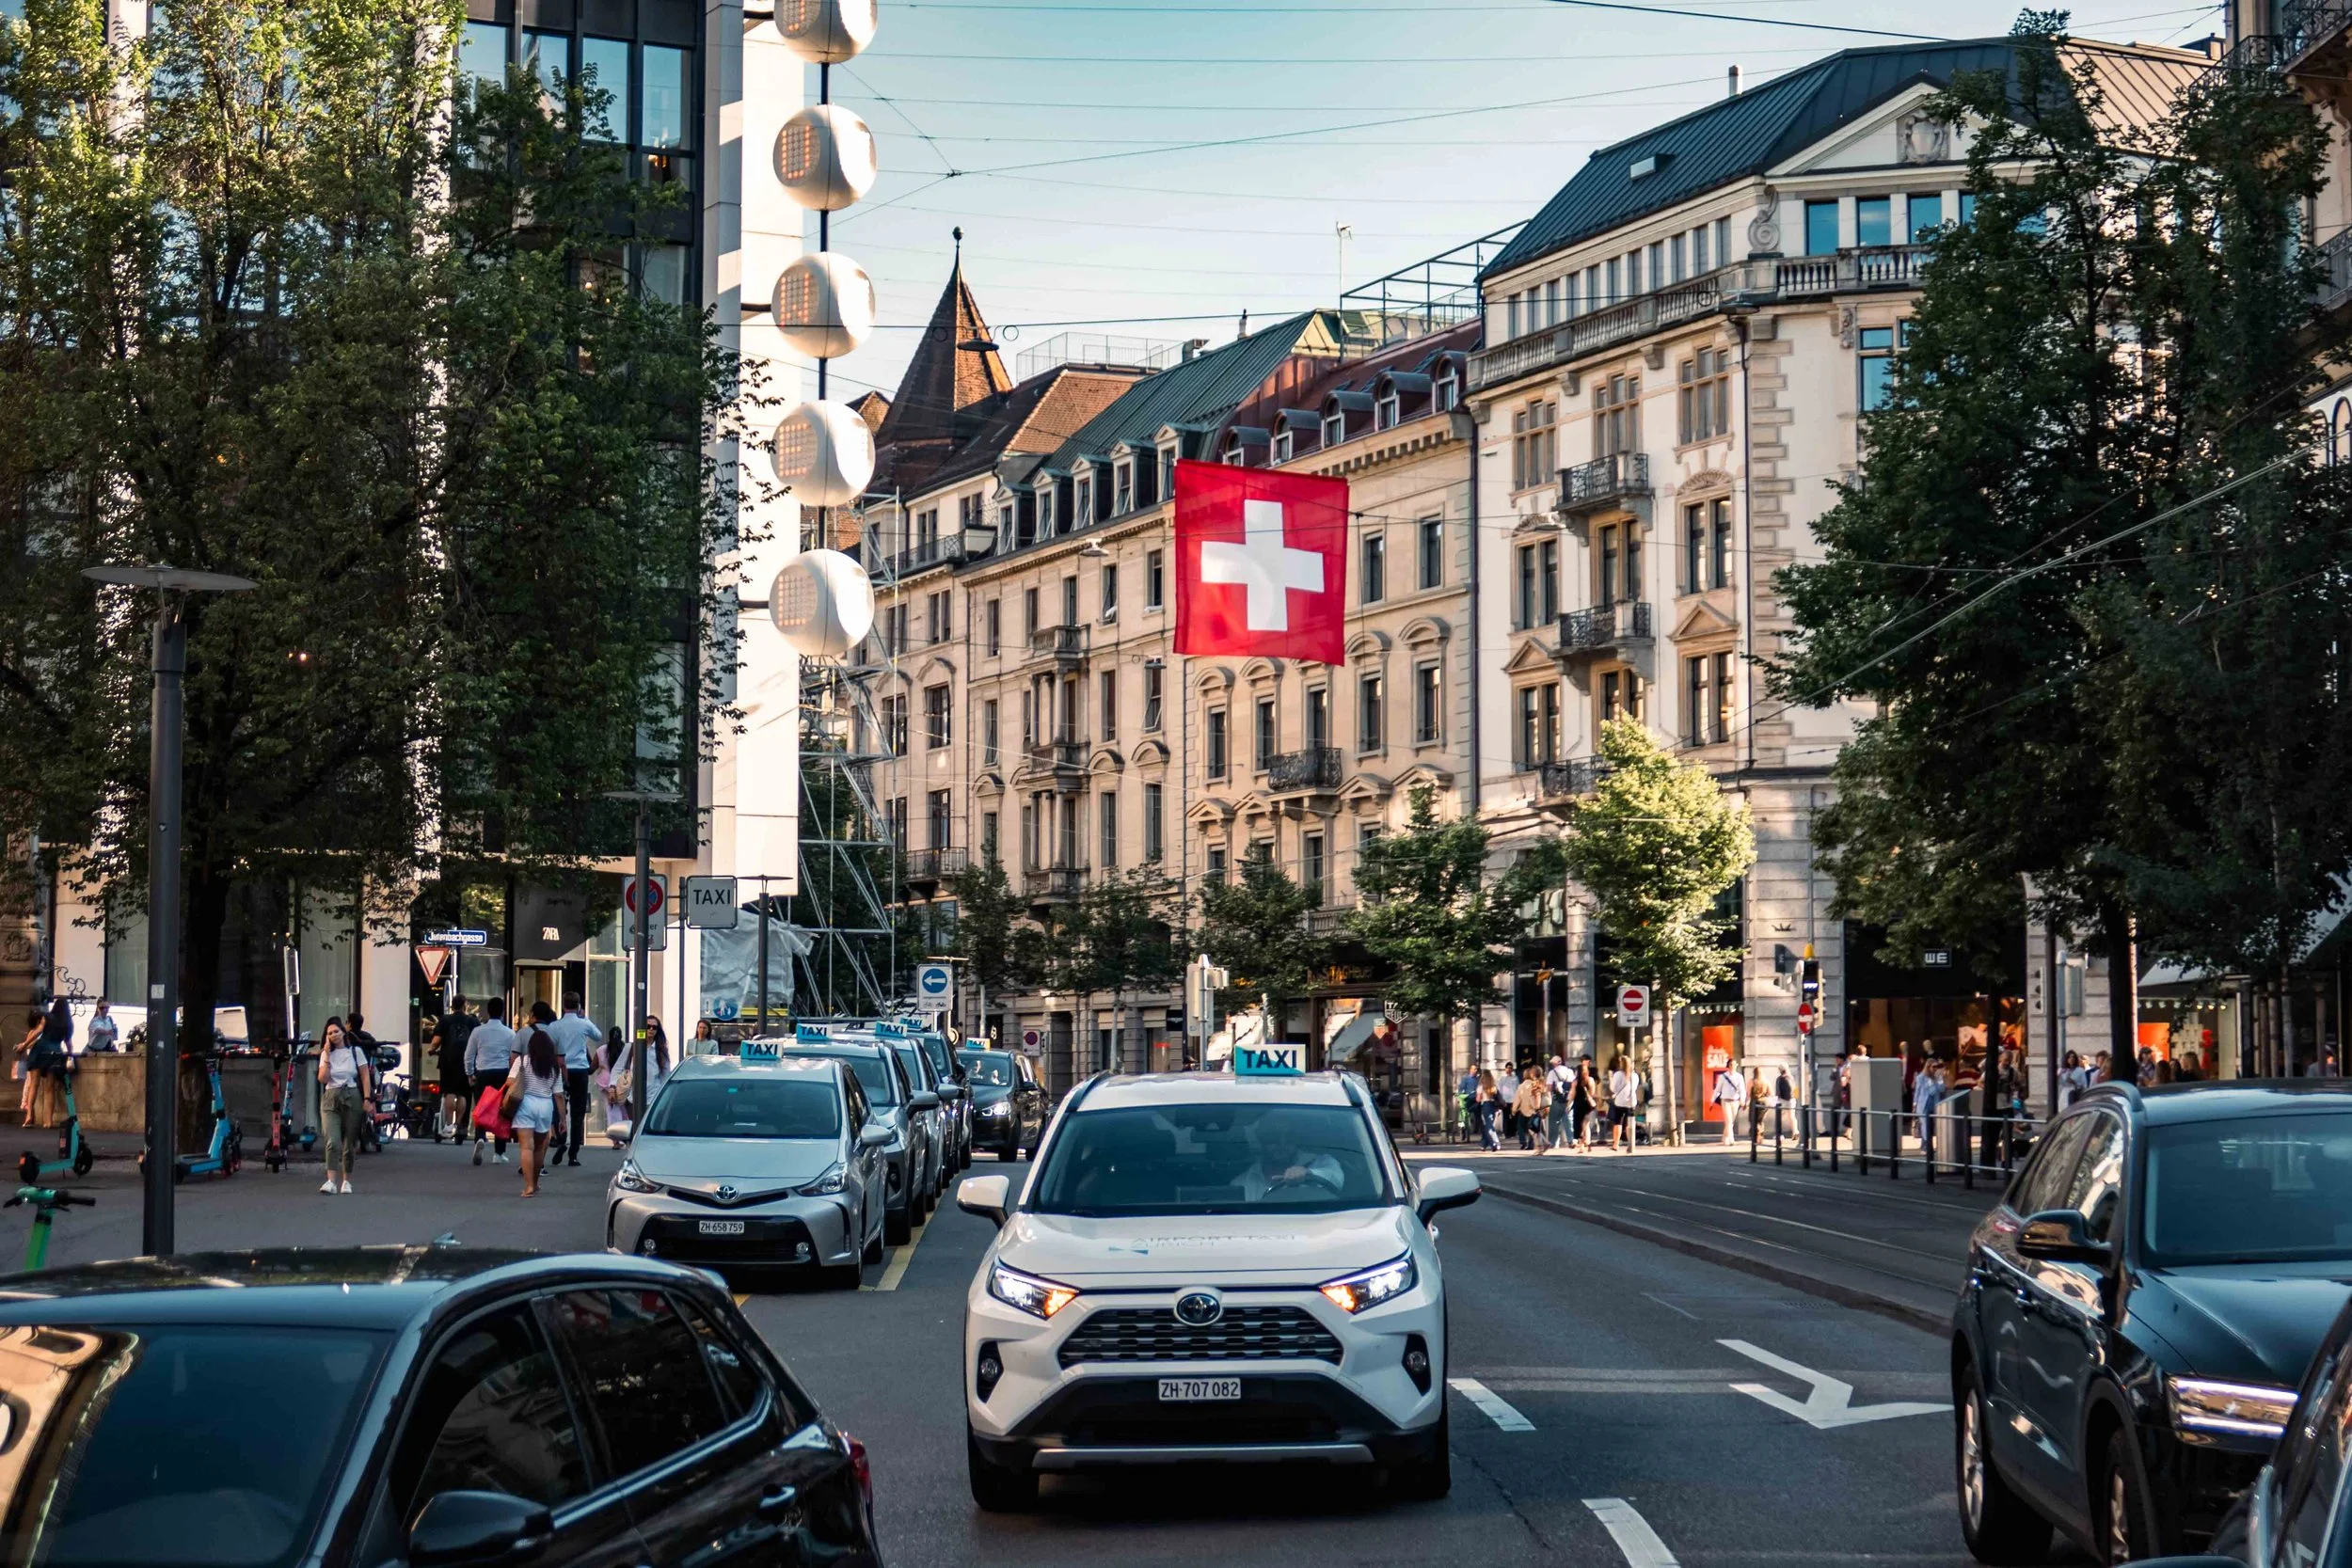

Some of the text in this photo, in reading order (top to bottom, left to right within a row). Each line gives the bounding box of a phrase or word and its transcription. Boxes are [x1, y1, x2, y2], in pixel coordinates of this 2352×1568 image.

[693, 889, 731, 905] TAXI
[542, 927, 560, 941] ZARA
[1925, 952, 1948, 963] WE
[902, 1018, 923, 1027] TAXI
[802, 1026, 827, 1037] TAXI
[880, 1023, 904, 1035] TAXI
[746, 1043, 778, 1056] TAXI
[1243, 1050, 1297, 1069] TAXI
[700, 1223, 743, 1232] ZH 658 759
[1183, 1381, 1210, 1398] 707
[1212, 1381, 1240, 1398] 082
